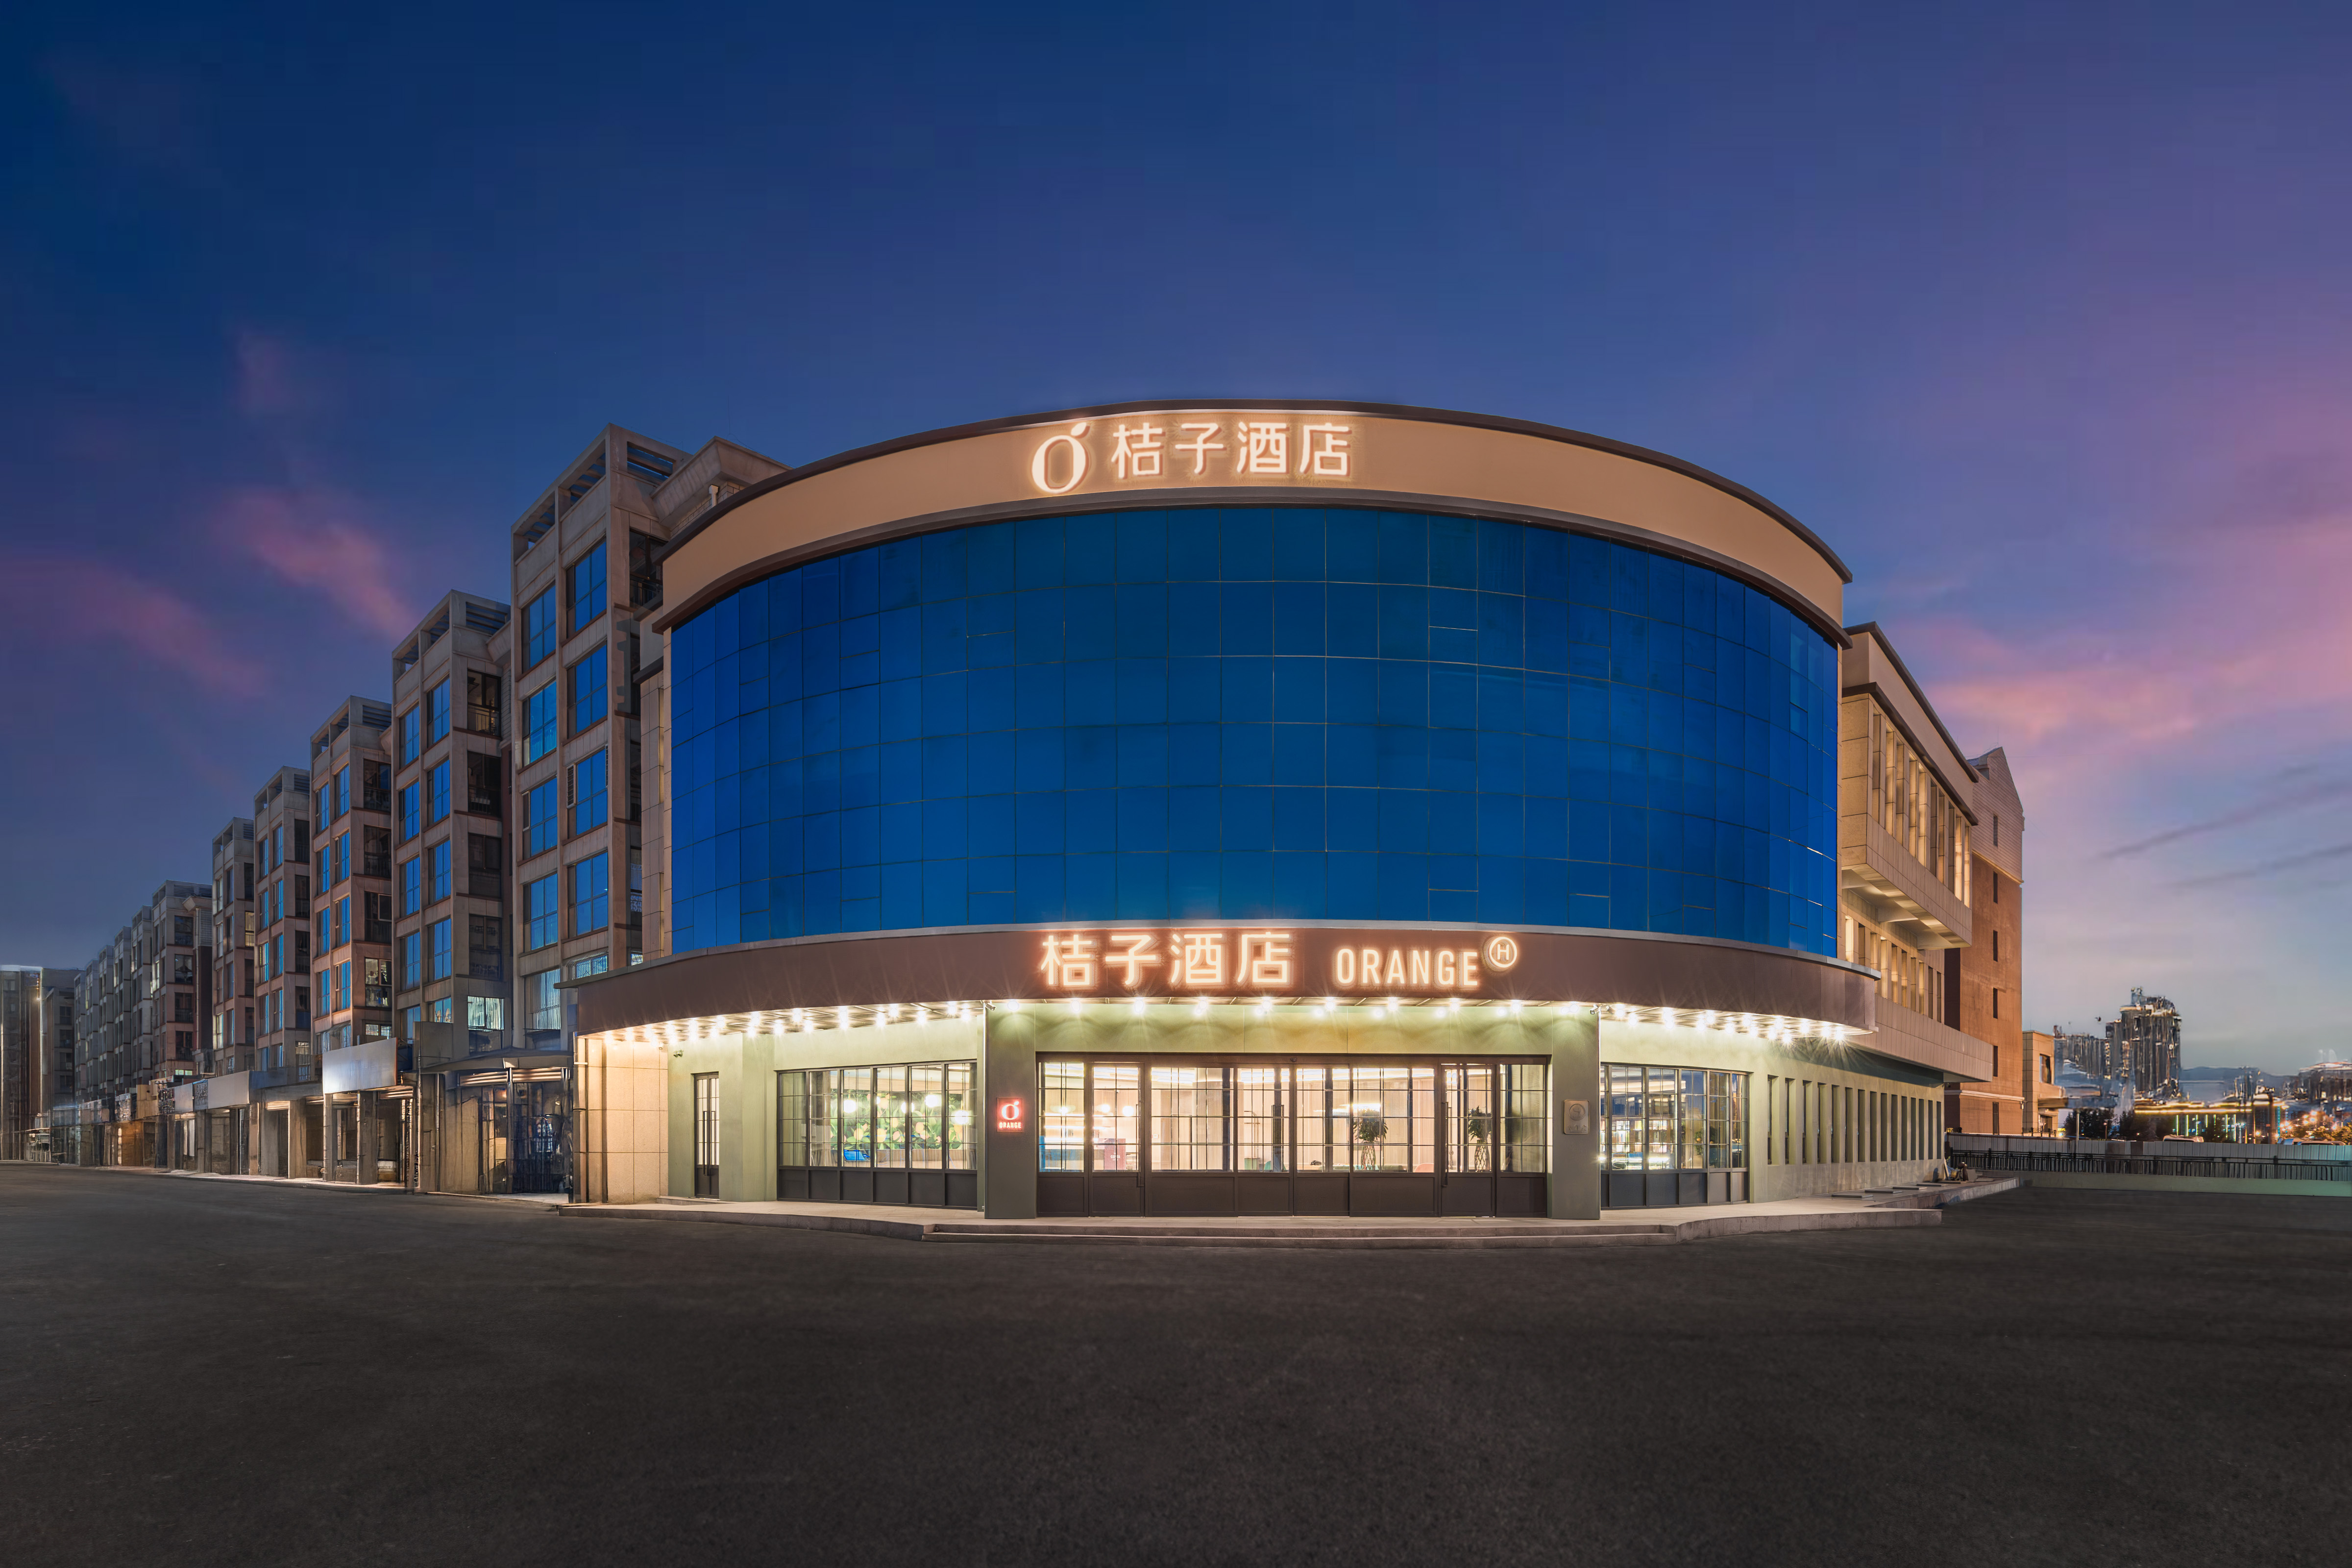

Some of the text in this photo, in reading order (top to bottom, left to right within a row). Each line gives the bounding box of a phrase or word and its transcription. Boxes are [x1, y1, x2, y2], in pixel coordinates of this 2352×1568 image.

[1111, 422, 1349, 479] 桔子酒店
[1041, 931, 1290, 986] 桔子酒店
[1337, 949, 1478, 986] ORANGE
